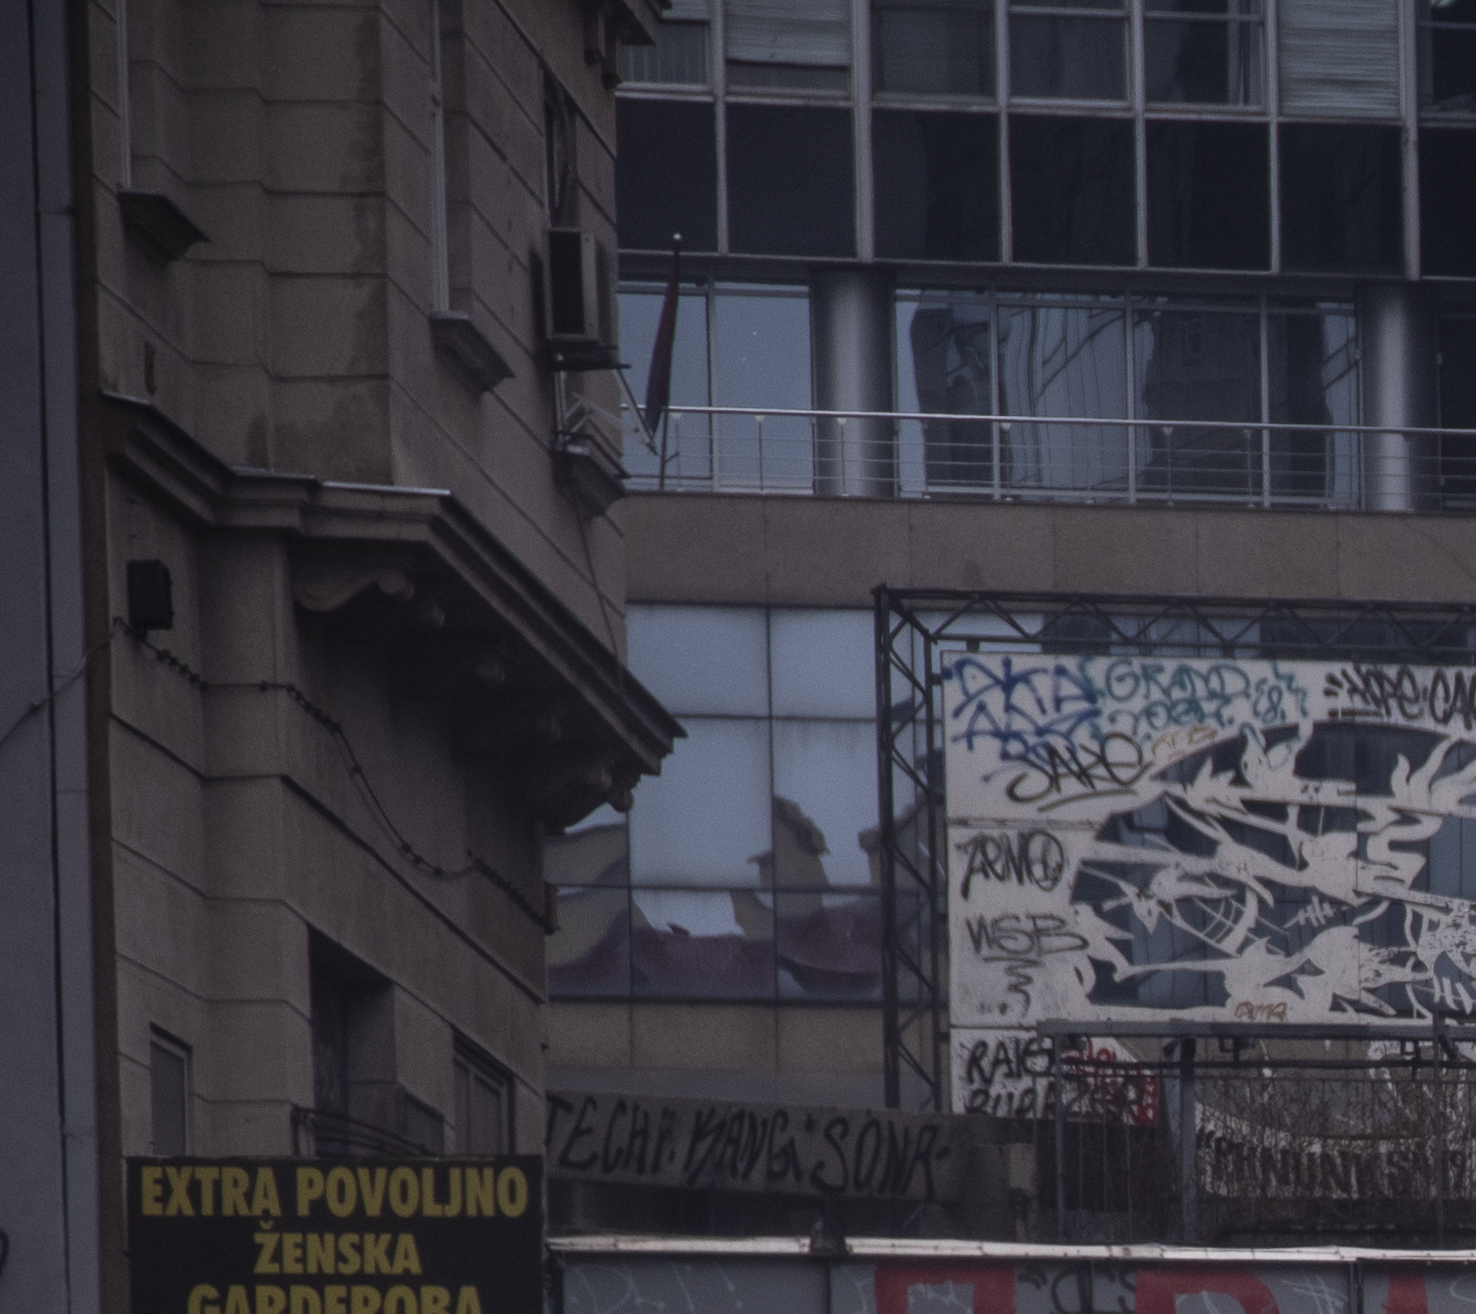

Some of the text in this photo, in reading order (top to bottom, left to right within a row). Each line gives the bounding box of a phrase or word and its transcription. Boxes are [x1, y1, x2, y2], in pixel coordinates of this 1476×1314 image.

[141, 1165, 529, 1218] EXTRA POVOLJNO
[253, 1220, 423, 1275] ŽENSKA
